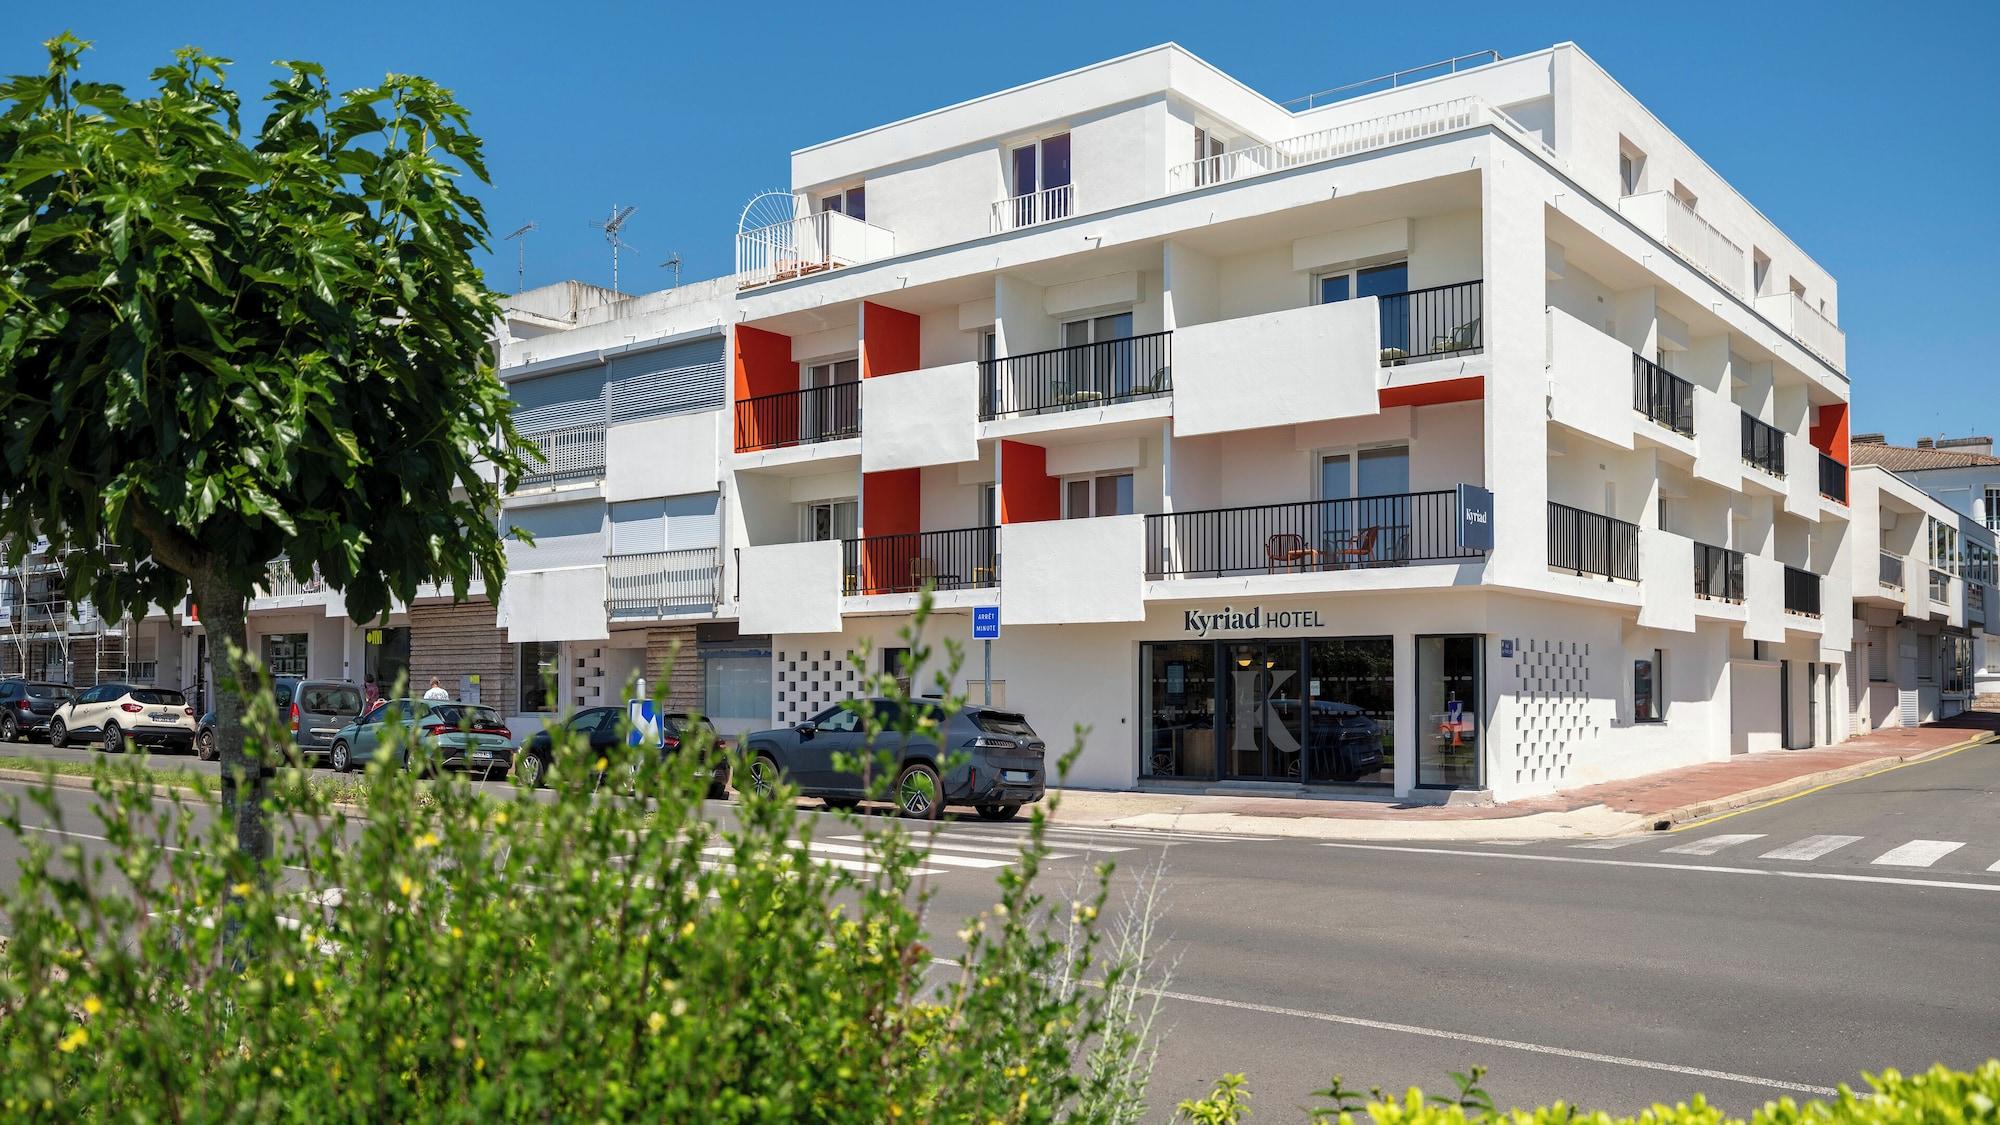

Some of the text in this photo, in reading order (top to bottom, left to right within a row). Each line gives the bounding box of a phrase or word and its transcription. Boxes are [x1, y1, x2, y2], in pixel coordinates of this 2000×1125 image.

[1466, 508, 1487, 525] Kyriad
[976, 624, 996, 632] MINUTE
[1184, 606, 1325, 637] Kyriad HOTEL
[1231, 670, 1302, 752] K
